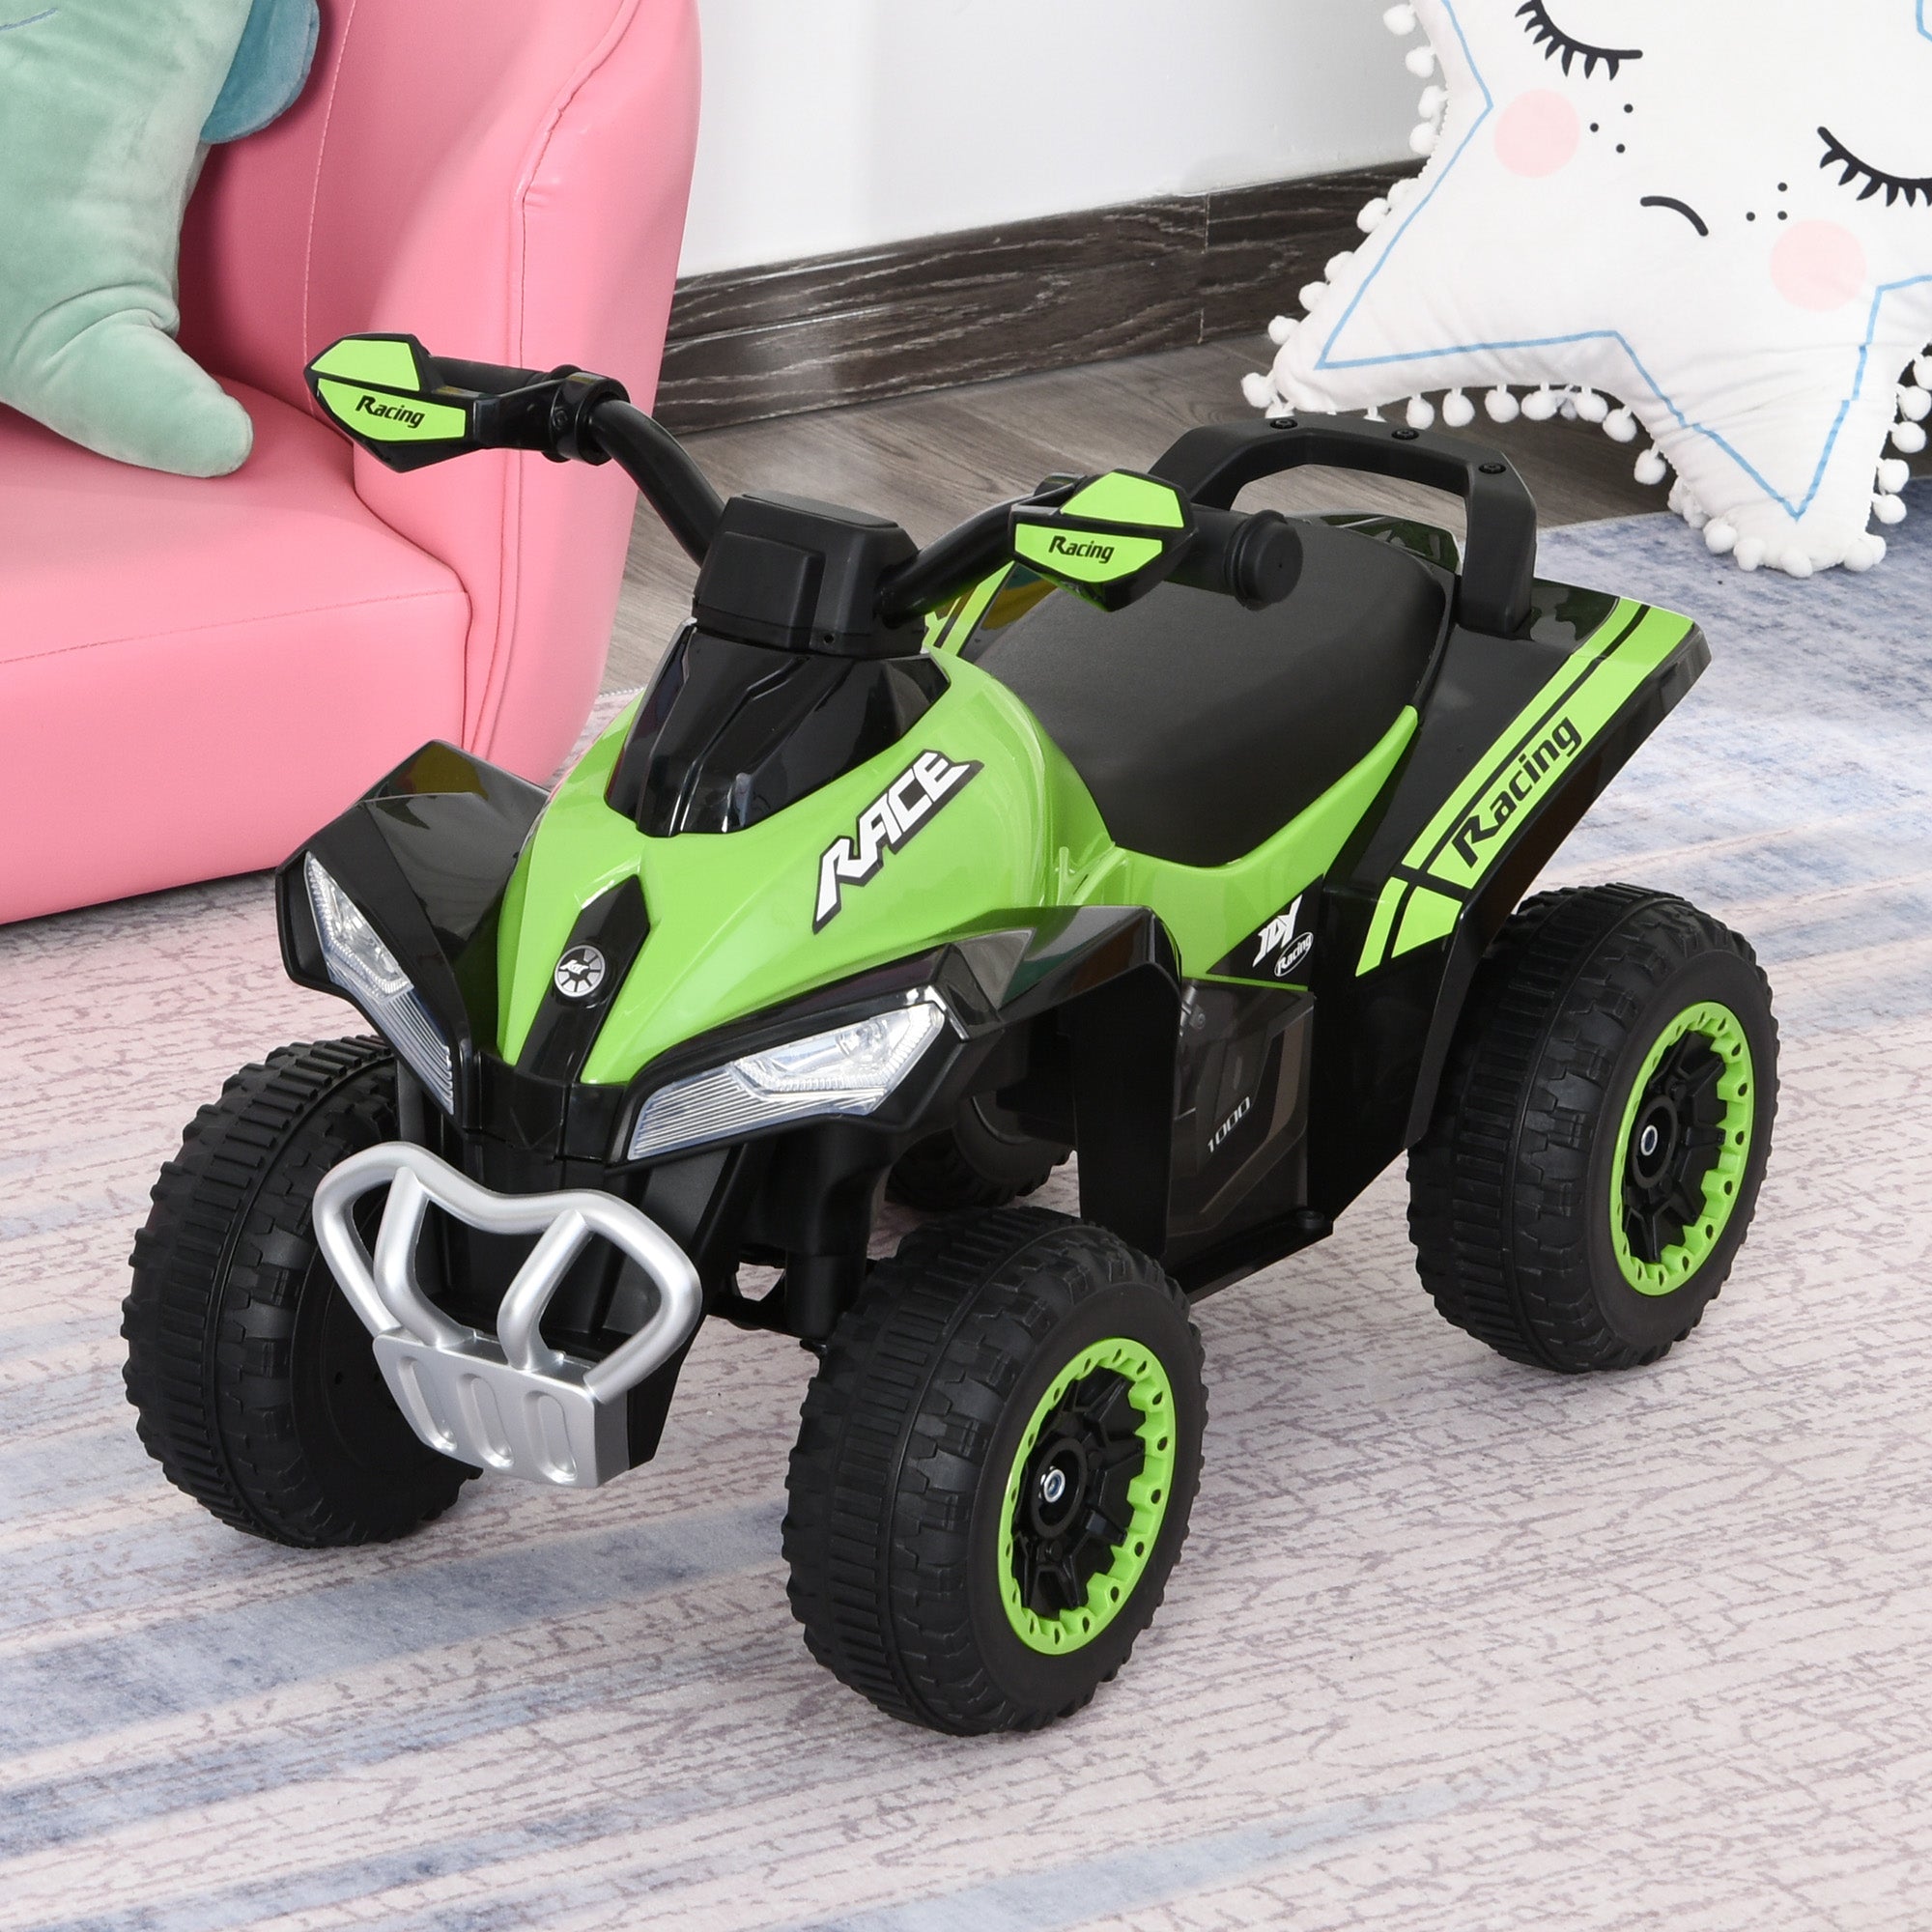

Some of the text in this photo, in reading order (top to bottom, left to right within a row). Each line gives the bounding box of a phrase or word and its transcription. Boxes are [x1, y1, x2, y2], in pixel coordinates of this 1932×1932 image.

[355, 394, 425, 429] Racing
[1048, 535, 1115, 564] Racing
[1451, 716, 1582, 868] Racing
[814, 751, 974, 926] RACE
[1277, 934, 1313, 976] Racing
[1208, 1096, 1251, 1153] 1000
